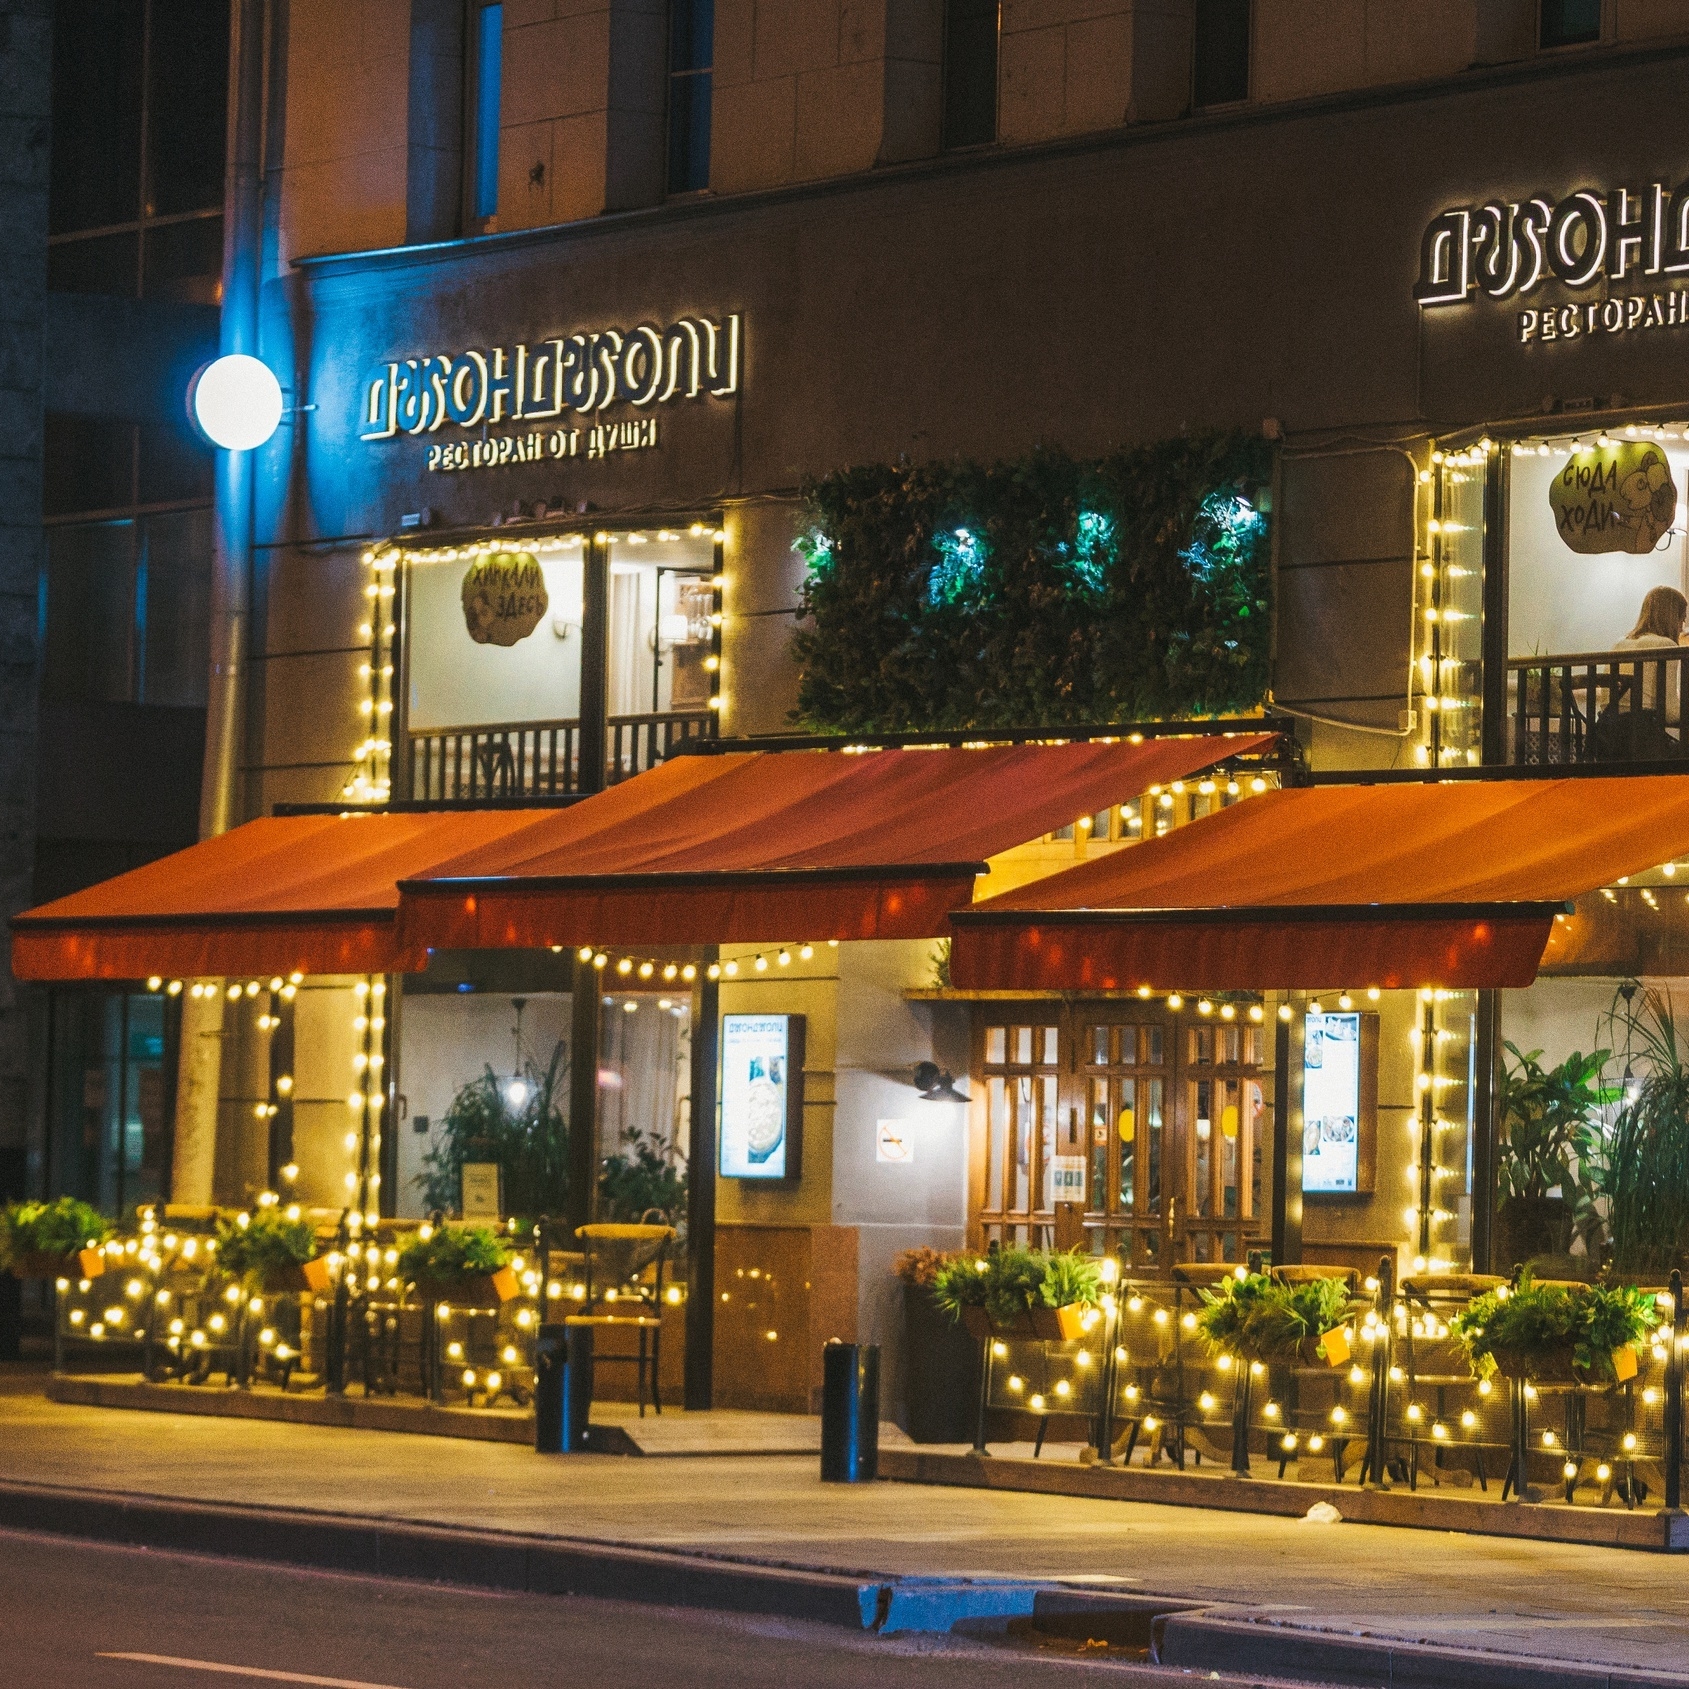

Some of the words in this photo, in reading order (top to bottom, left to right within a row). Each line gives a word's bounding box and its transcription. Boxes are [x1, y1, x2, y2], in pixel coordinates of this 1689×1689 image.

[1518, 290, 1689, 342] РЕСТОРАН
[360, 313, 740, 441] ДЖОНДЖОЛИ
[427, 431, 542, 471] РЕСТОРАН
[549, 427, 580, 459] ОТ
[588, 418, 657, 459] ДУШИ
[1563, 460, 1617, 498] СЮДА
[1560, 499, 1616, 535] ХОДИ
[495, 592, 545, 622] ЗДЕСЬ
